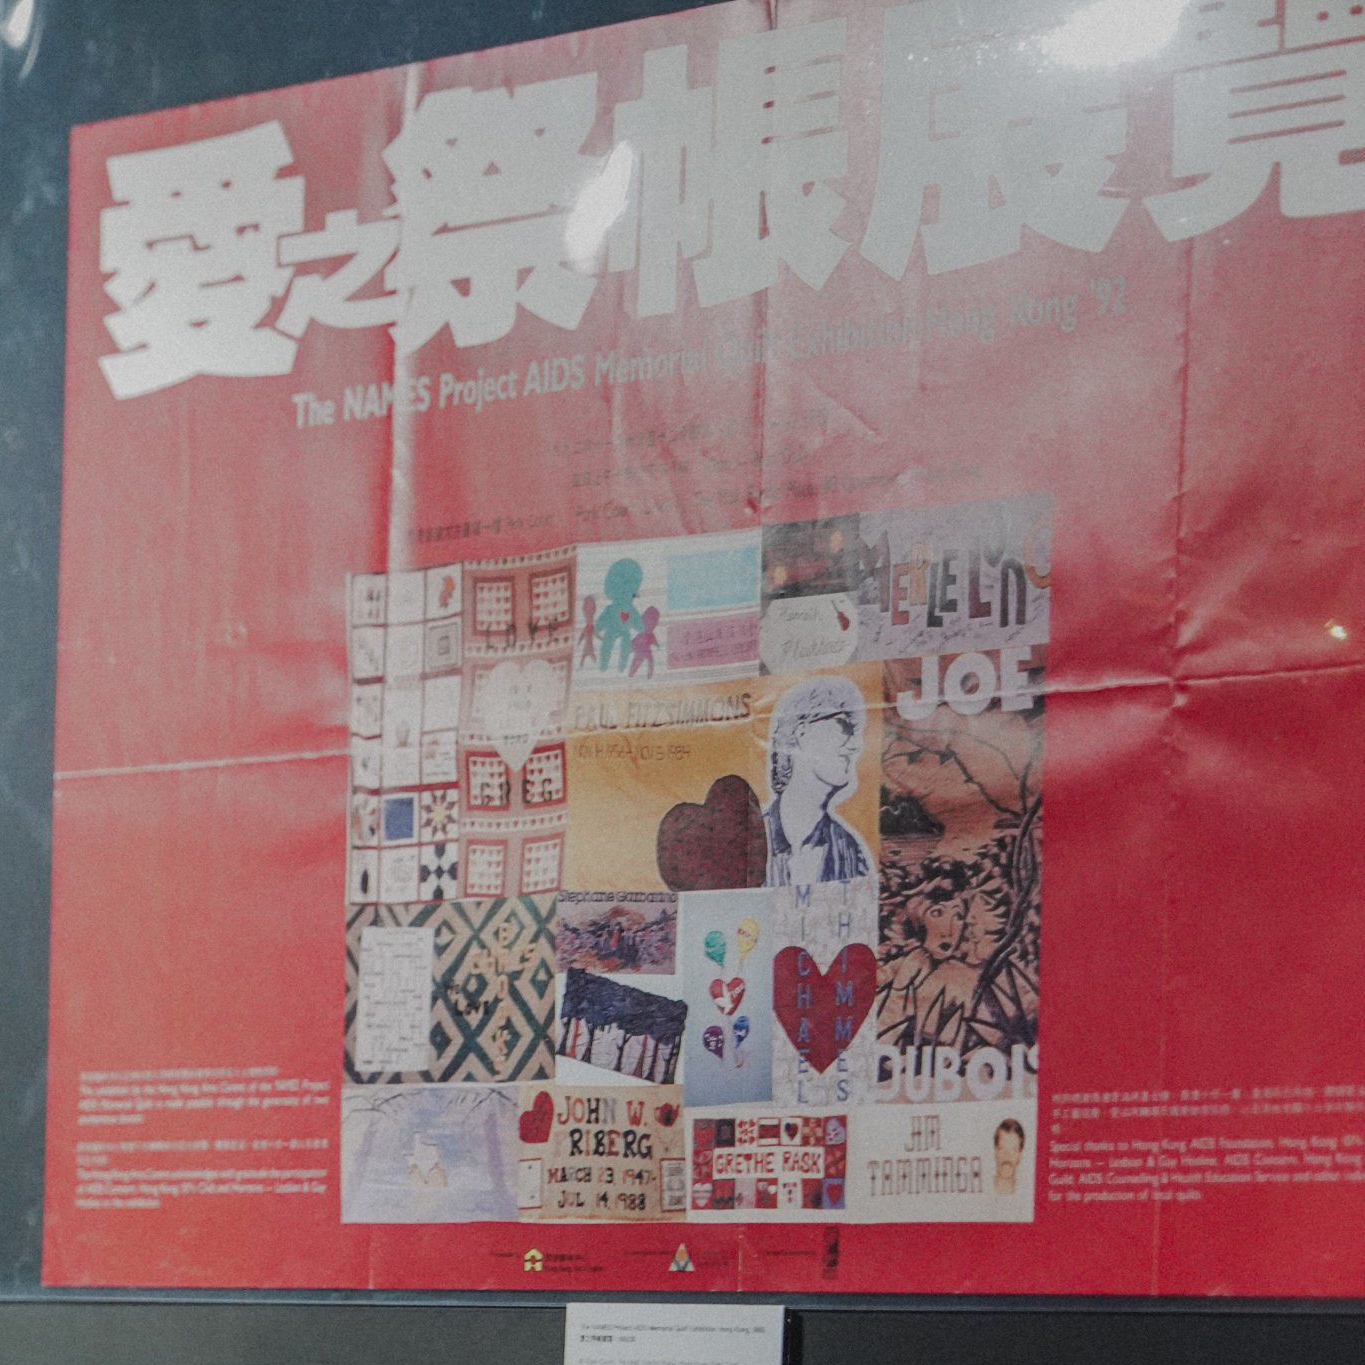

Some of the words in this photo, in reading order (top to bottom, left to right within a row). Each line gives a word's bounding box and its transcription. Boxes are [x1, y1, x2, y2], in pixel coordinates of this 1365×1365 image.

[292, 392, 335, 429] The
[343, 376, 431, 421] NAMES
[438, 367, 518, 412] Project
[523, 354, 586, 397] AIDS
[896, 646, 1035, 722] JOE
[557, 1097, 616, 1126] JOHN
[714, 1152, 774, 1175] GRETHE
[781, 1152, 822, 1175] RASK
